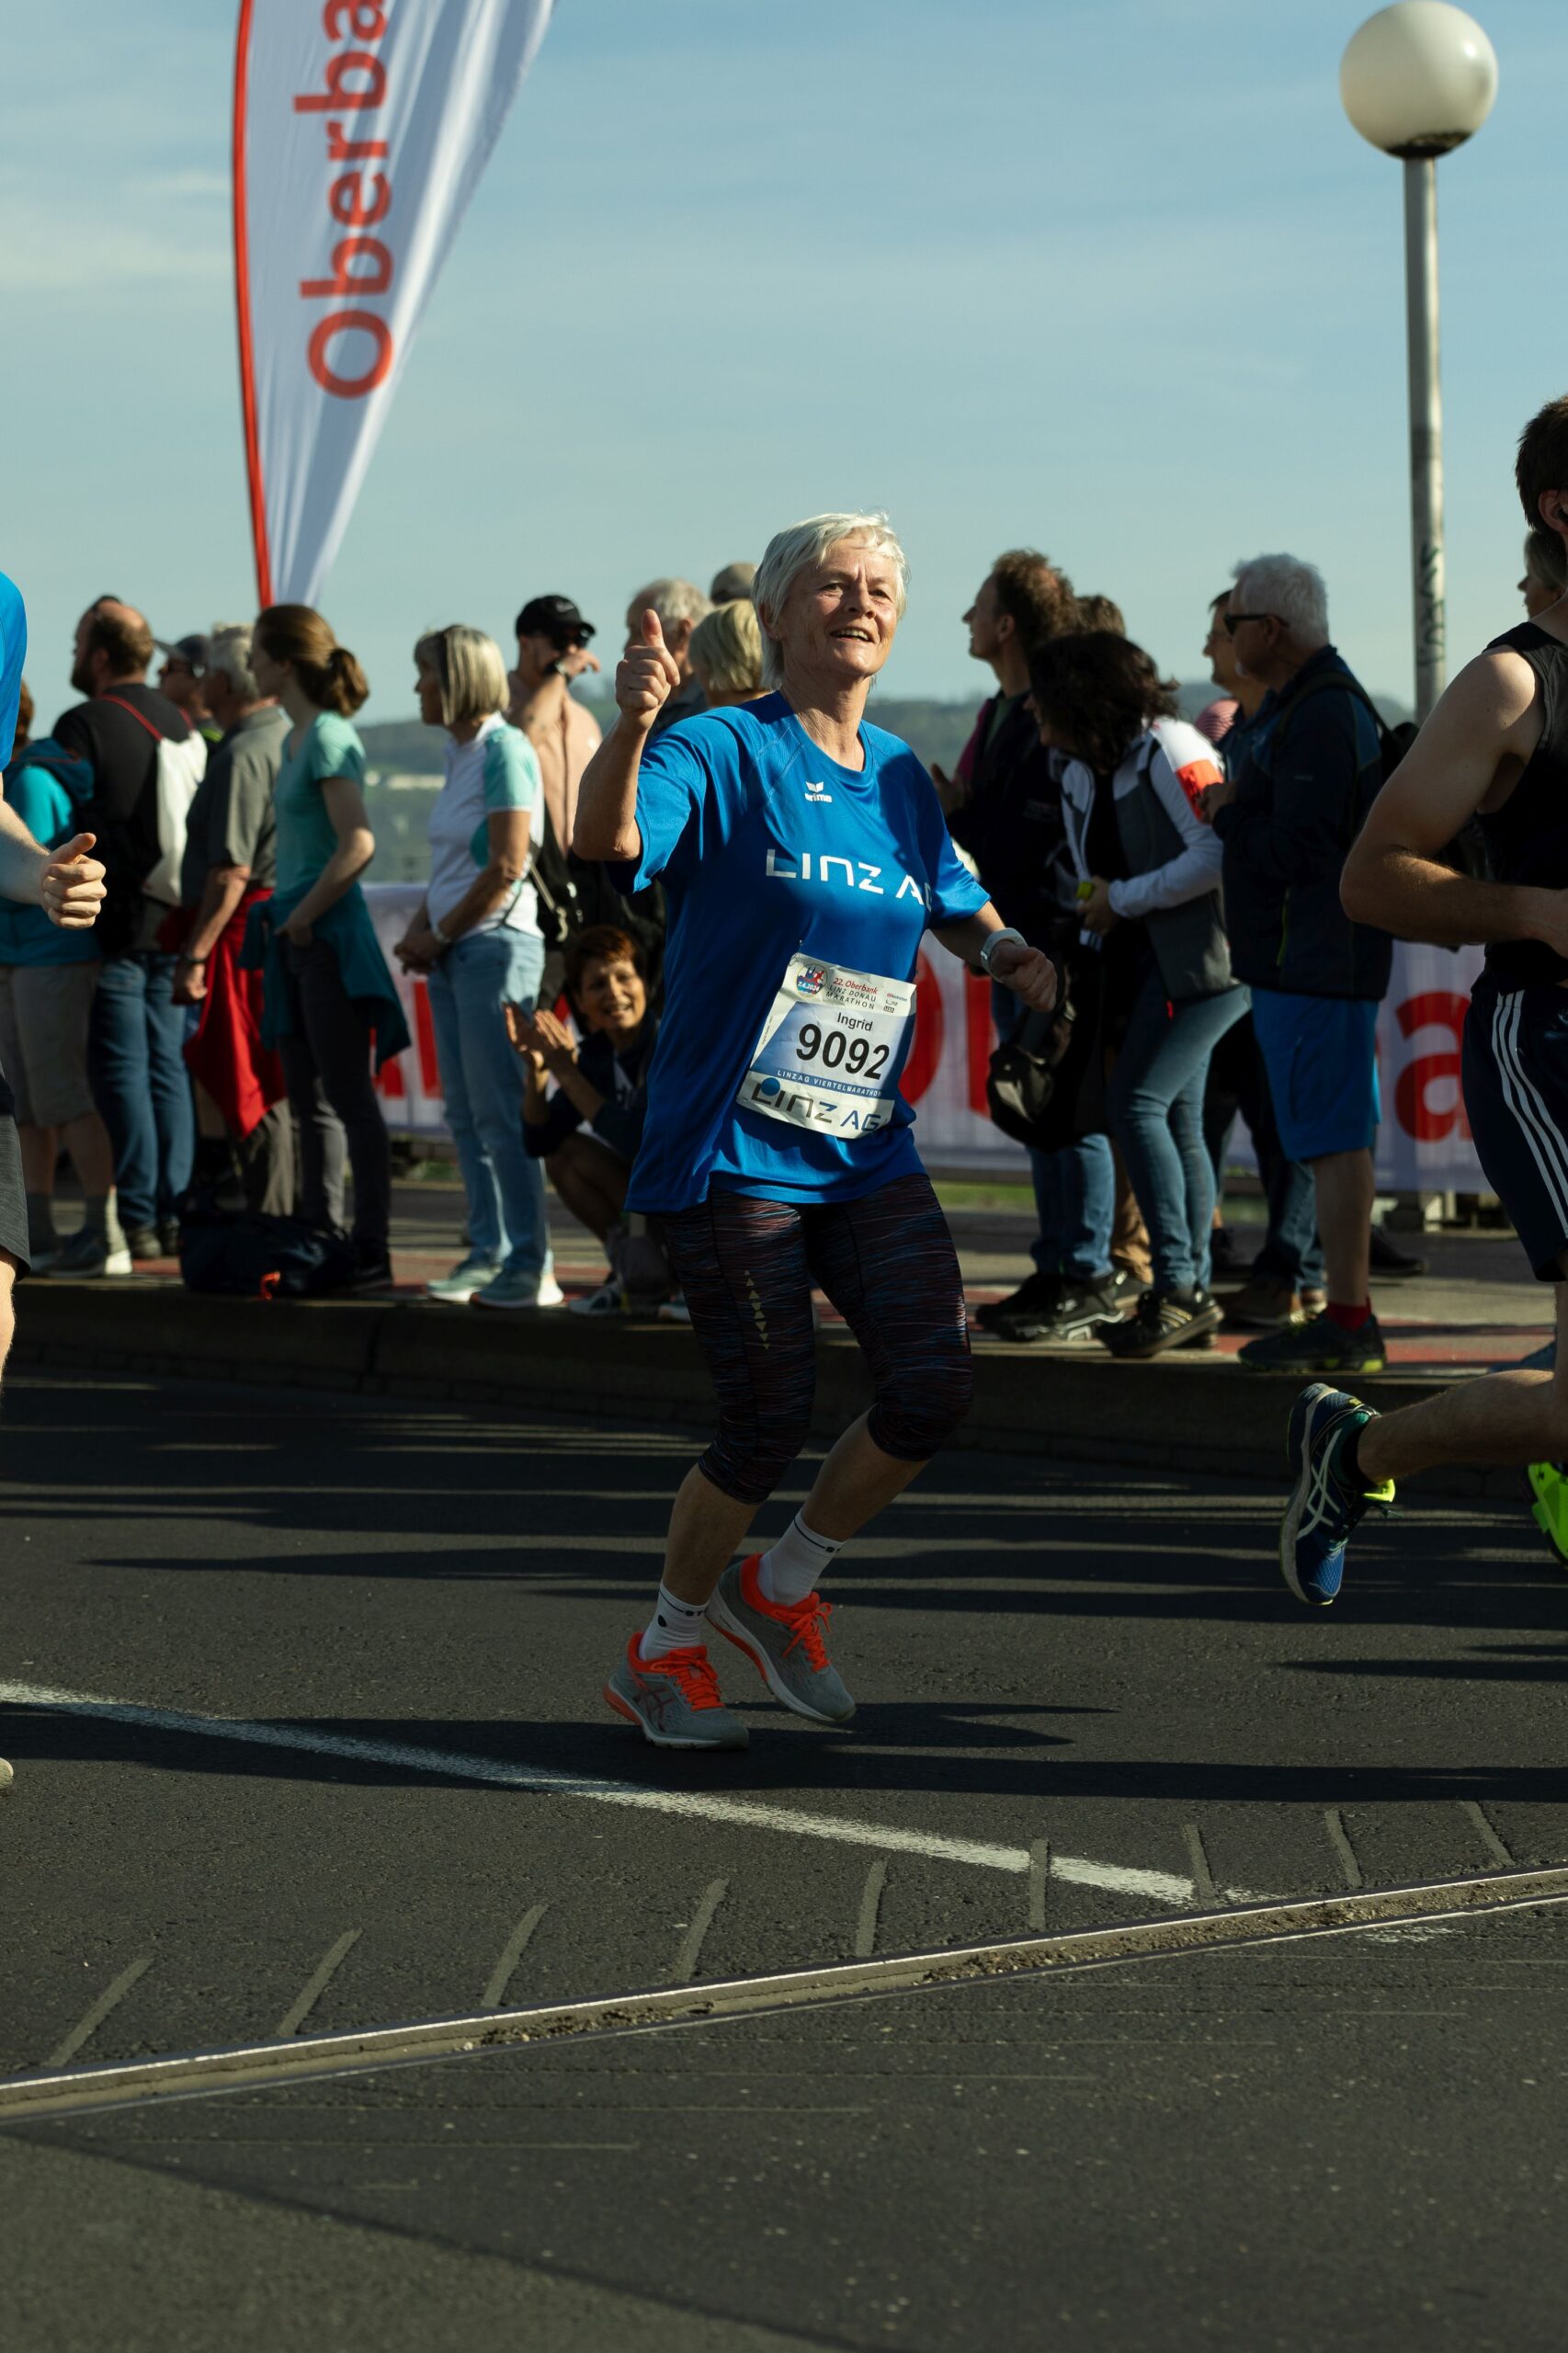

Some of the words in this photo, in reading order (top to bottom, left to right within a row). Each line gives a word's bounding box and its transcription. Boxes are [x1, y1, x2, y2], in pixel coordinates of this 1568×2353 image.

[829, 985, 846, 995] LINZ
[848, 990, 877, 1002] DONAU
[845, 980, 879, 995] Oberbank
[825, 991, 875, 1010] MARATHON
[836, 1012, 873, 1032] Ingrid
[796, 1023, 890, 1081] 9092
[813, 1077, 882, 1097] VIERTELMARATHON
[840, 1109, 881, 1131] AG
